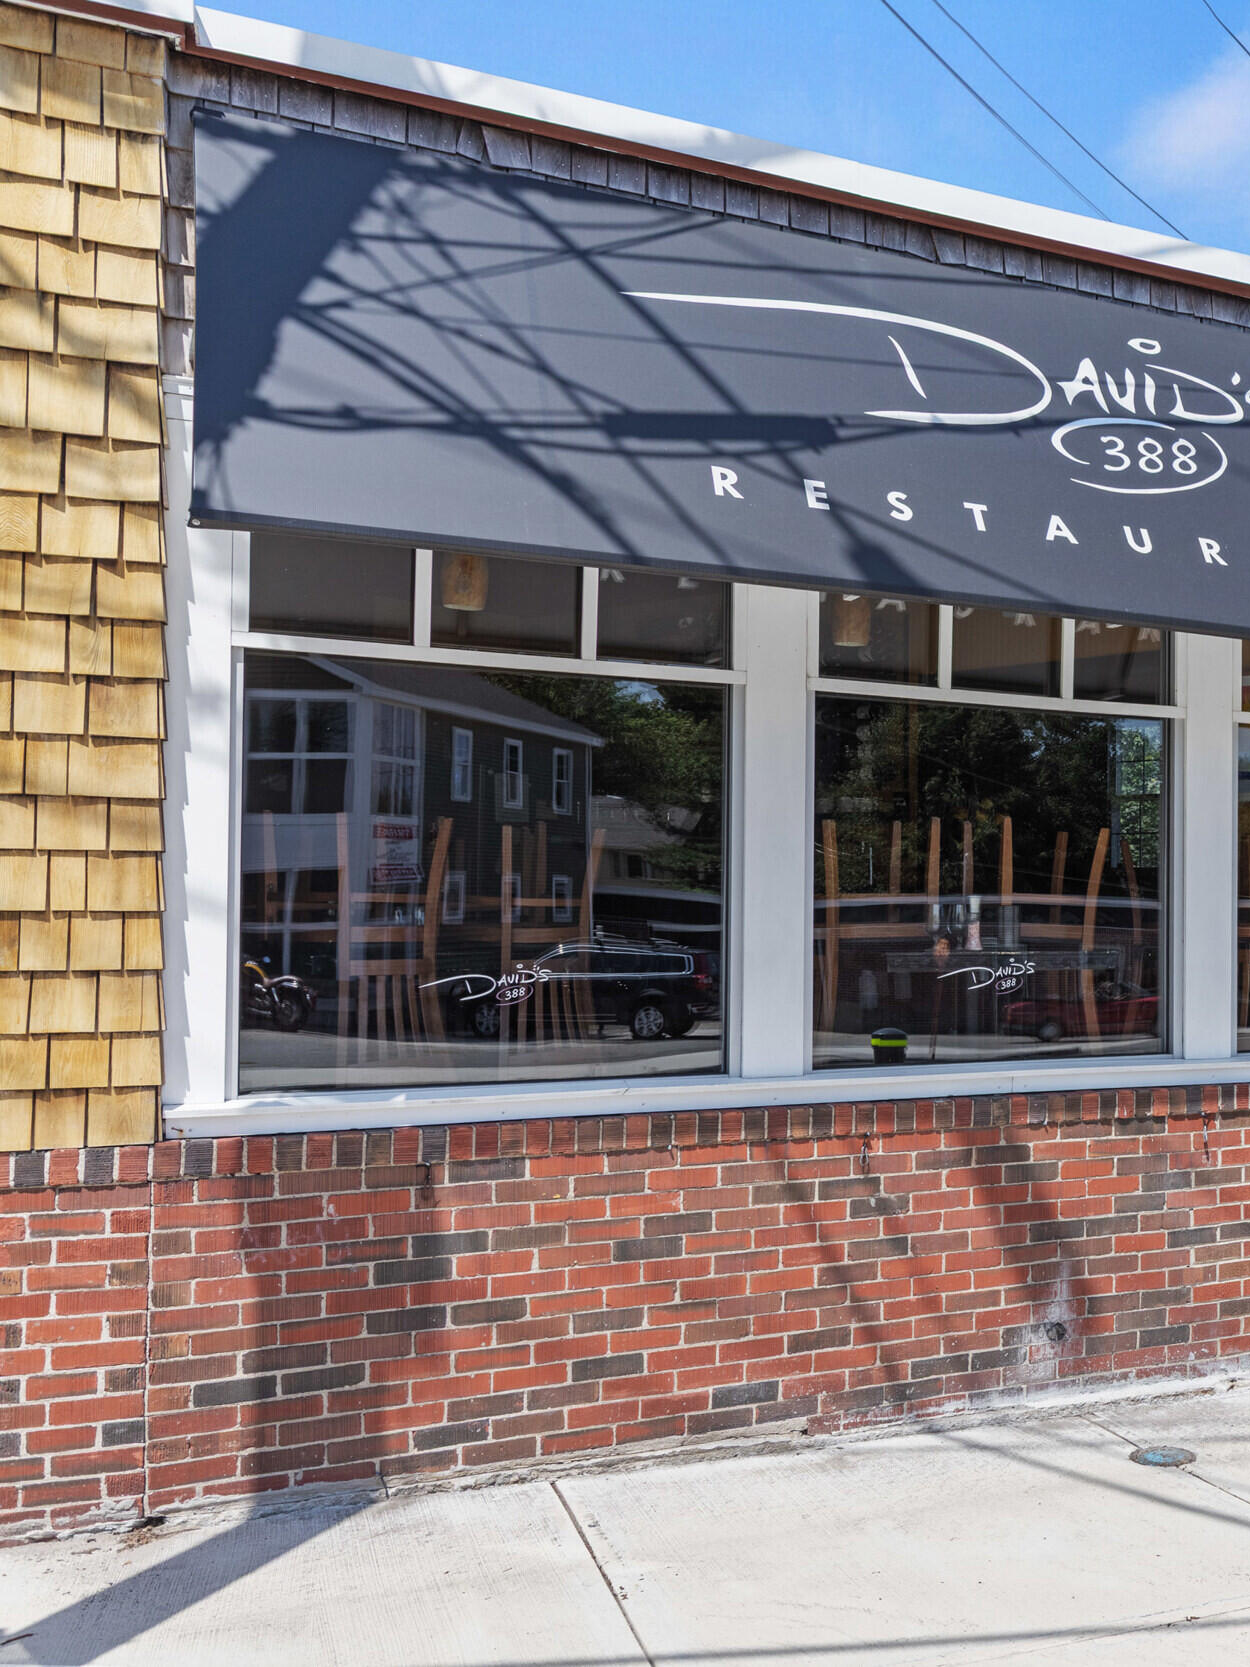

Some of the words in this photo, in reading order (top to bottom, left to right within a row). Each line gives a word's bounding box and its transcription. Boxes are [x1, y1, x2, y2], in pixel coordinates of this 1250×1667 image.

[1101, 435, 1199, 476] 388
[1001, 977, 1017, 990] 388
[504, 986, 526, 1001] 388
